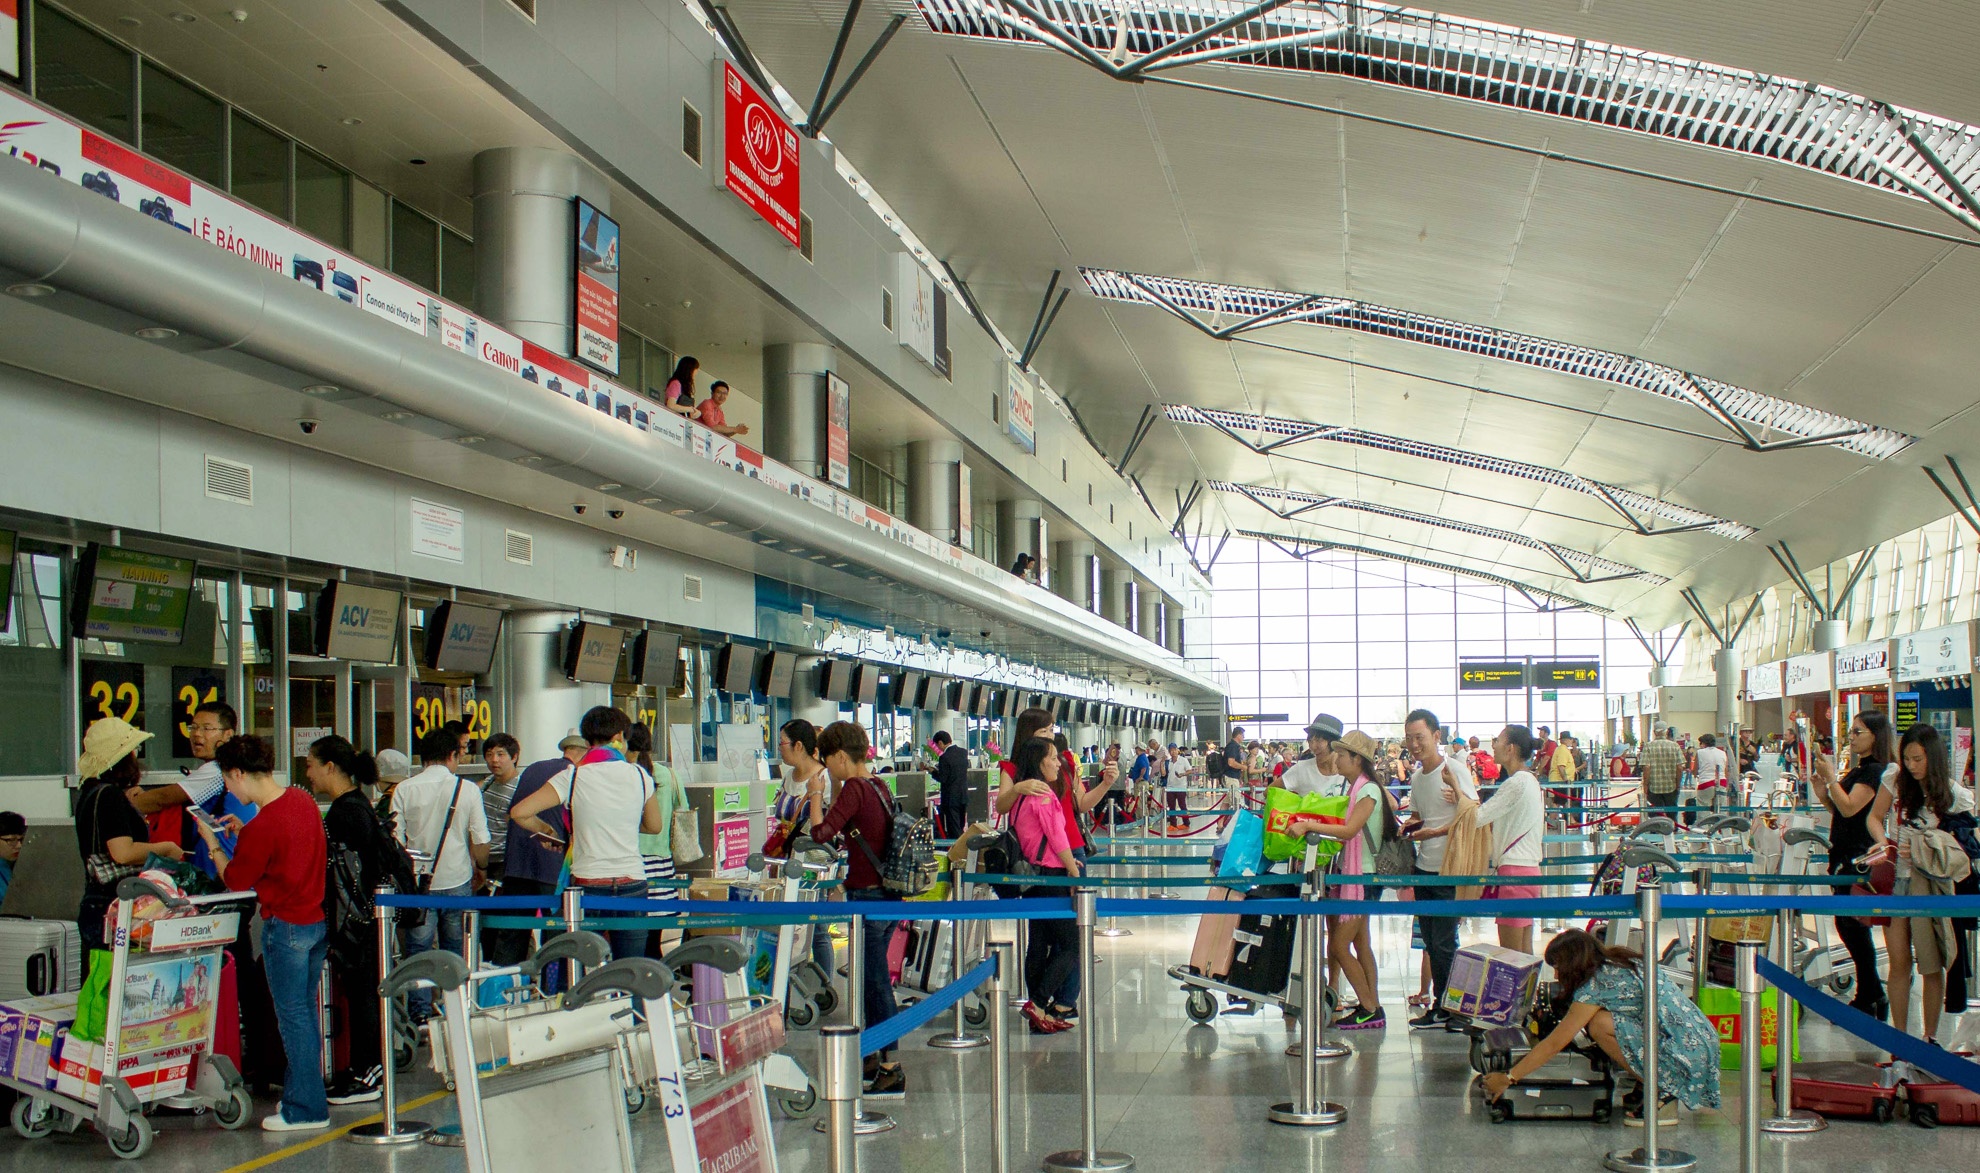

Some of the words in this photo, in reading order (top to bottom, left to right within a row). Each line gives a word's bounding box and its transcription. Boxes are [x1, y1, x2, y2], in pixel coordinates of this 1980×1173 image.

[216, 225, 246, 257] BẢO
[250, 243, 283, 274] MINH
[366, 293, 386, 312] Canon
[483, 341, 519, 373] Canon
[121, 565, 170, 584] NANNING
[340, 605, 370, 627] ACV
[142, 627, 168, 636] NANNING
[449, 623, 475, 642] ACV
[584, 640, 604, 656] ACV
[1838, 654, 1855, 675] LUCKY
[1854, 653, 1867, 672] GIFT
[1866, 650, 1886, 670] SHOP
[90, 680, 140, 729] 32
[415, 697, 443, 739] 30
[466, 700, 491, 740] 29
[115, 927, 126, 947] 333
[180, 925, 212, 937] HDBank
[710, 1137, 759, 1173] AGRIBANK
